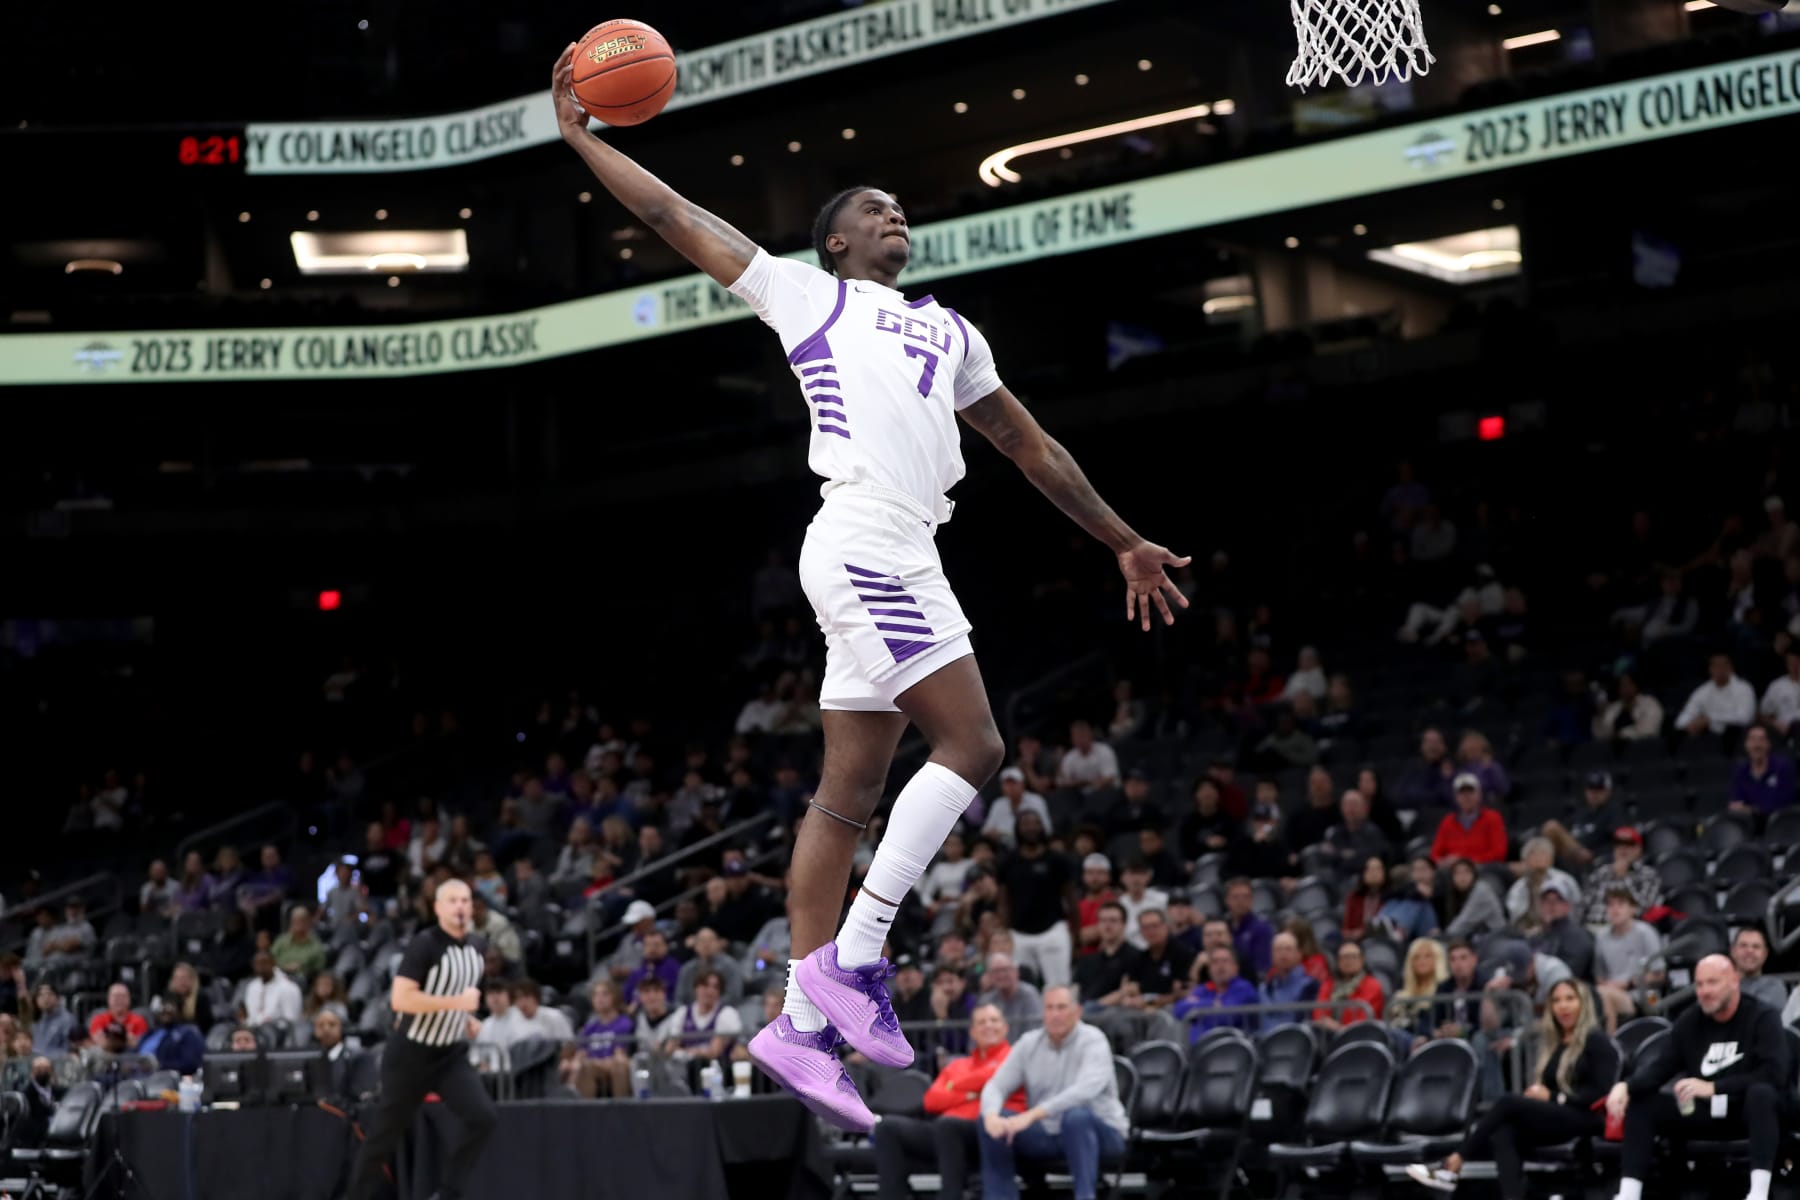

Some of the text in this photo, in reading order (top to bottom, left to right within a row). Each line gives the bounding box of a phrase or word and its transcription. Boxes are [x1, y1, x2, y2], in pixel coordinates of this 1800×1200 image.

[588, 34, 646, 59] LEGACY
[773, 2, 924, 75] BASKETBALL
[278, 126, 437, 165] COLANGELO
[446, 105, 528, 156] CLASSIC
[1464, 112, 1530, 162] 2023
[1540, 91, 1628, 151] JERRY
[664, 282, 699, 325] THE
[965, 216, 1024, 260] HALL
[1032, 207, 1060, 247] OF
[1070, 192, 1134, 239] FAME
[131, 318, 539, 373] 2023 JERRY COLANGELO CLASSIC
[875, 307, 952, 356] GCU
[903, 343, 939, 399] 7
